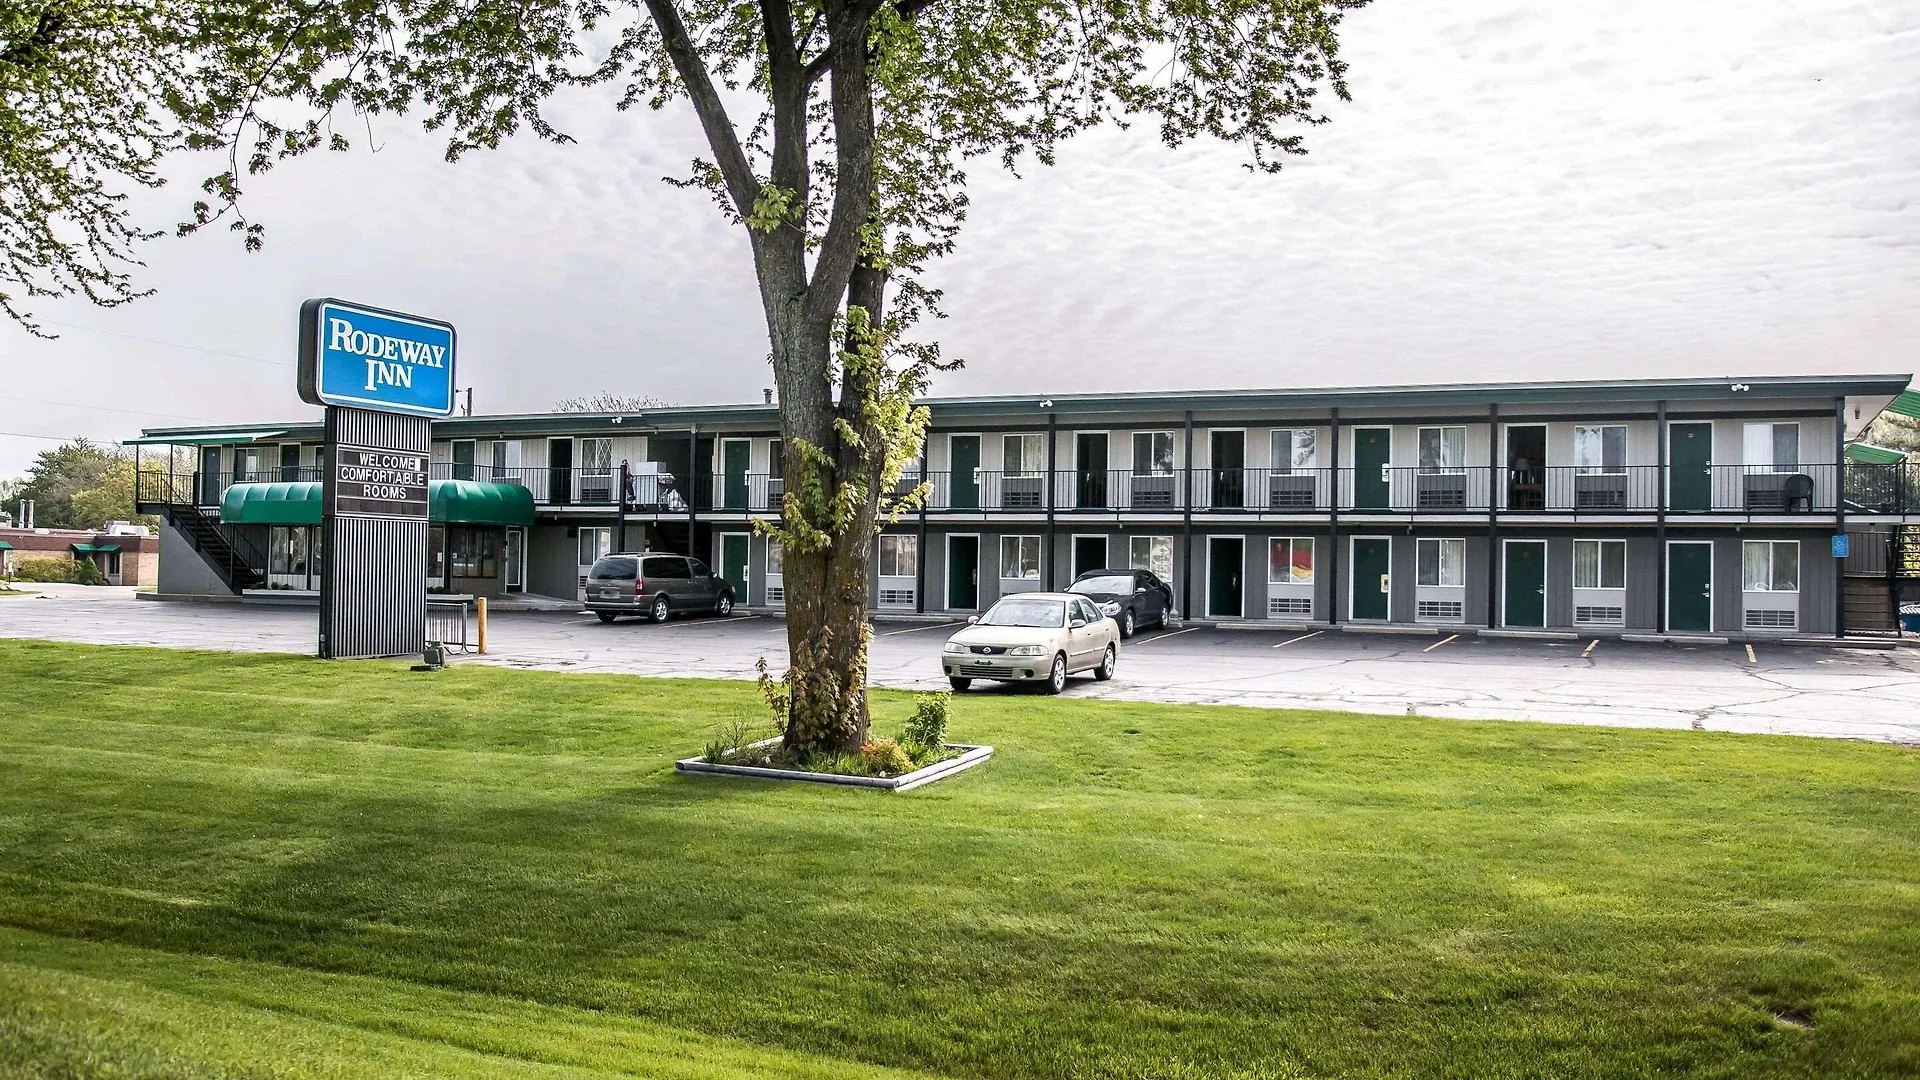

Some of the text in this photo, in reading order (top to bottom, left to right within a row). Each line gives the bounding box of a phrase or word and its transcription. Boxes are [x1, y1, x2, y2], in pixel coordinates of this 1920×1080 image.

[328, 317, 446, 369] RODEWAY
[364, 358, 413, 391] INN
[360, 452, 415, 470] WELCOME
[341, 467, 424, 486] COMFORTABLE
[363, 484, 406, 500] ROOMS
